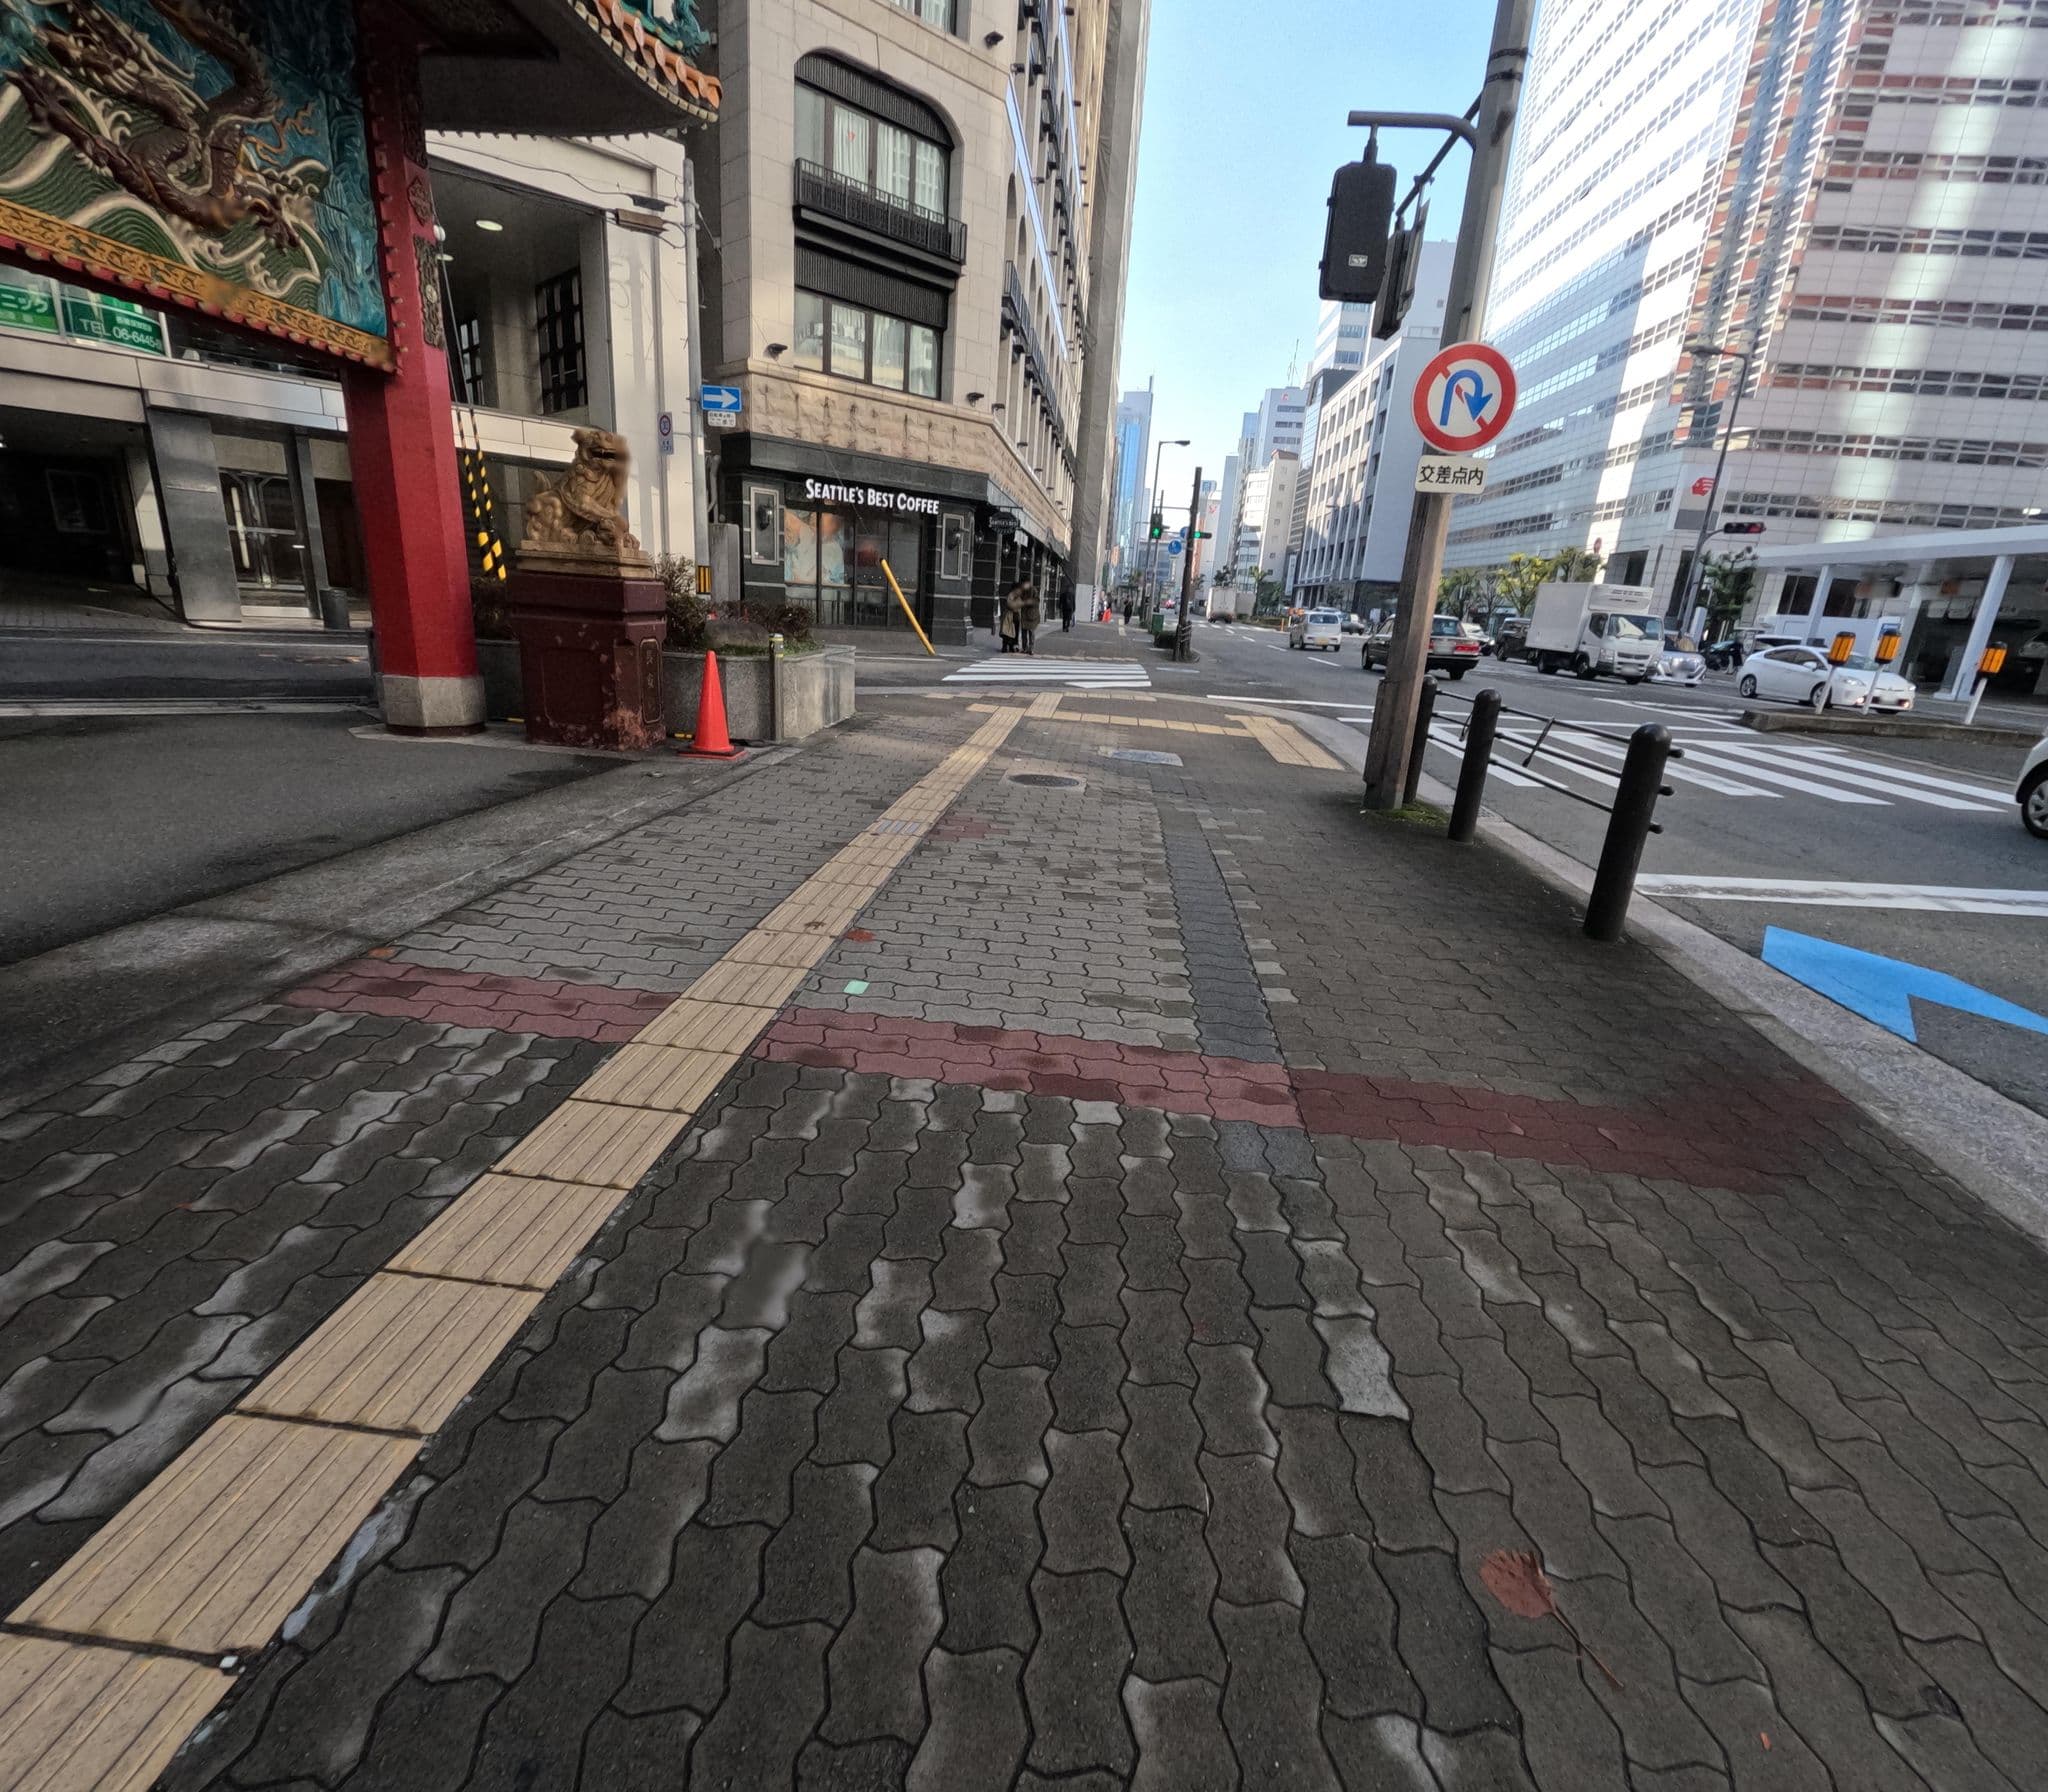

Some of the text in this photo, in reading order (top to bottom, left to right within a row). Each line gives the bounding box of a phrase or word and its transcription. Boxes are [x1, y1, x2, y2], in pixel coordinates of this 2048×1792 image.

[79, 319, 111, 337] TEL
[1418, 464, 1484, 486] 交差点内
[805, 478, 940, 515] SEATTLE'S BEST COFFEE
